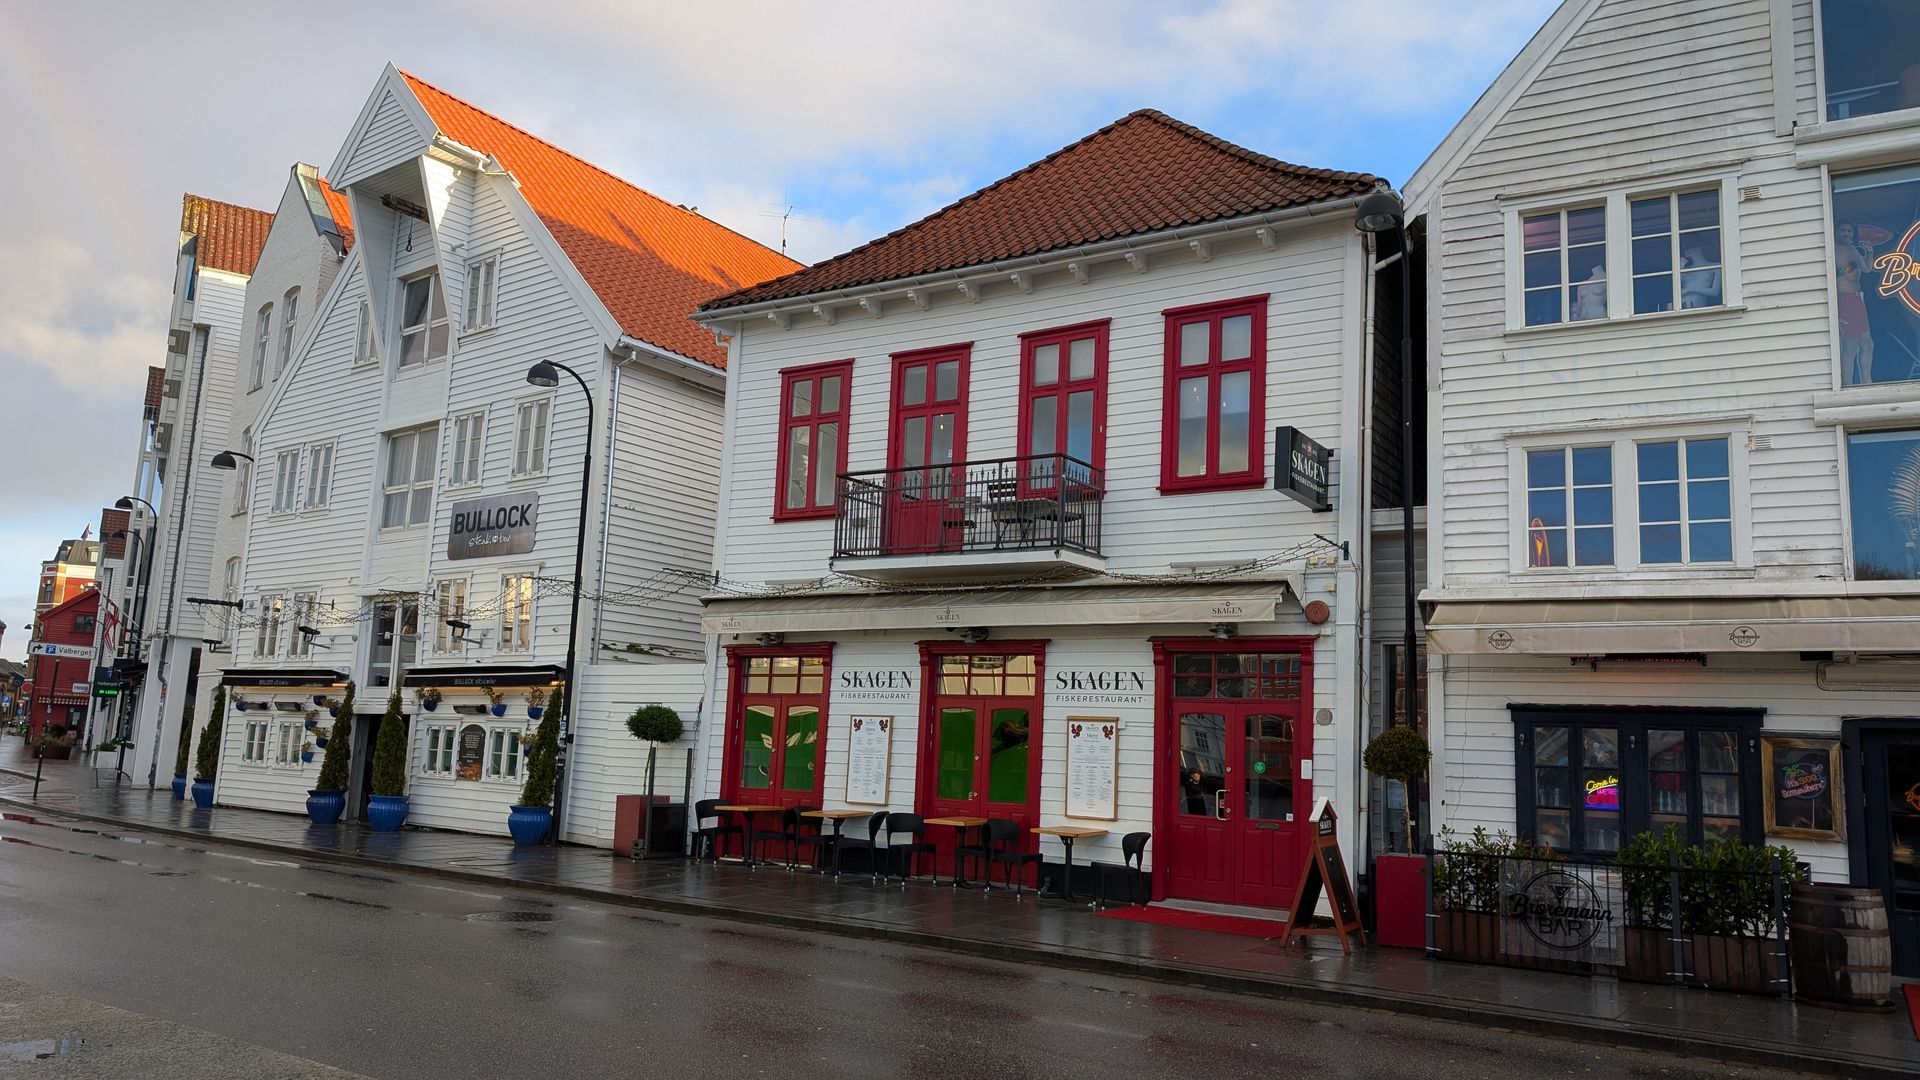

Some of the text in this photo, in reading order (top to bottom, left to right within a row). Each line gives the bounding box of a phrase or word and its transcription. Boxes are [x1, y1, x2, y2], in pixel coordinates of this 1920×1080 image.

[1874, 252, 1920, 297] Br
[1291, 449, 1326, 485] SKAGEN
[453, 503, 533, 535] BULLOCK
[1211, 606, 1243, 615] SKAGEN
[59, 647, 92, 657] Valberget
[841, 670, 914, 689] SKAGEN
[1056, 670, 1145, 691] SKAGEN
[840, 692, 911, 700] FISKERESTAURANT
[1056, 695, 1143, 704] FISKERESTAURANT
[1586, 780, 1608, 792] Come
[1539, 918, 1583, 937] BAR
